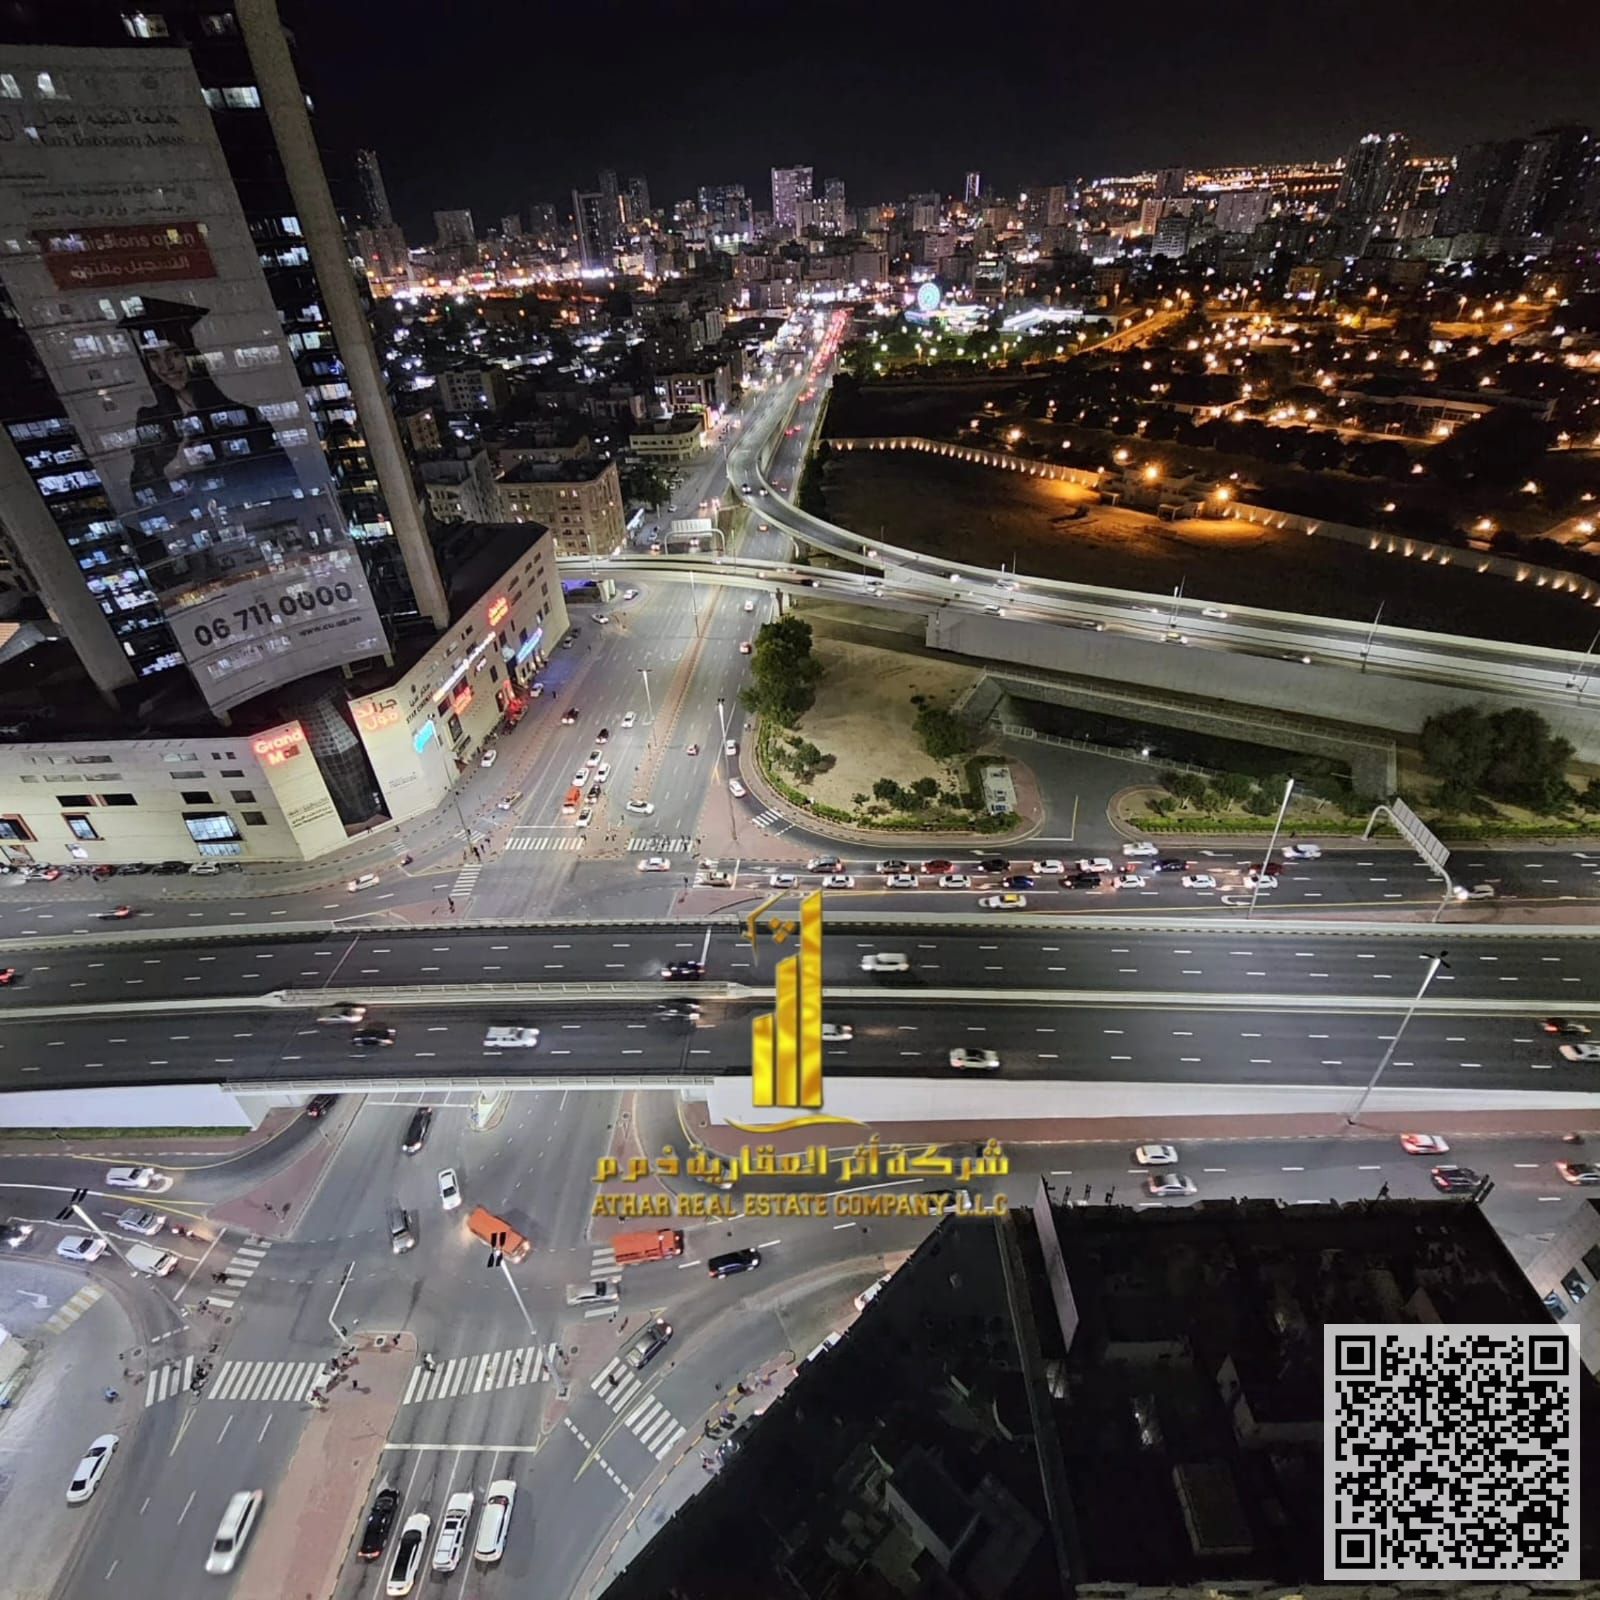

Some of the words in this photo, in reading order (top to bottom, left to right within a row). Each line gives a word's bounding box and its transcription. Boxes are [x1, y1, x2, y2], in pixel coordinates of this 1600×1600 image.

[193, 618, 231, 647] 06
[233, 602, 273, 631] 711
[278, 582, 353, 616] 0000
[255, 730, 303, 754] Grand
